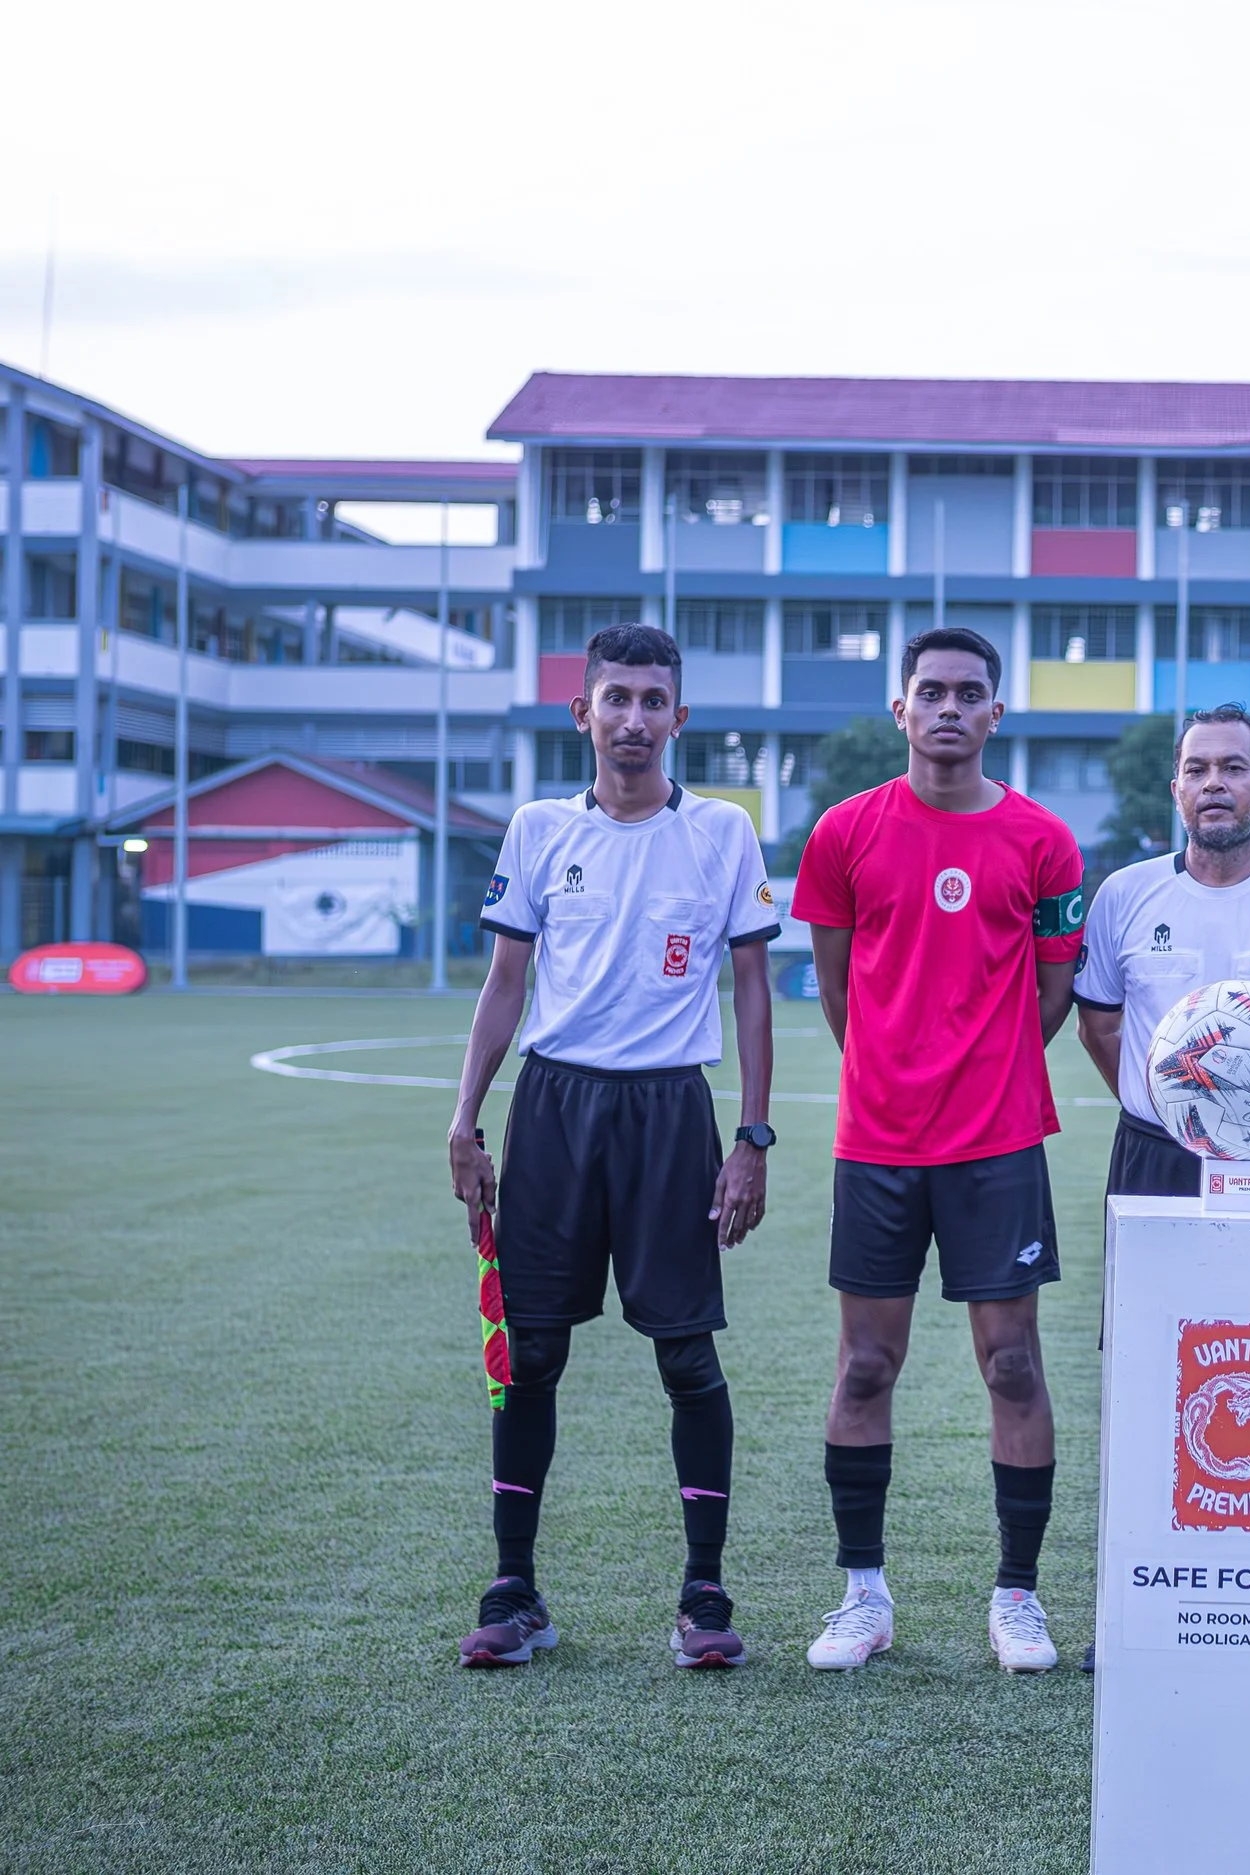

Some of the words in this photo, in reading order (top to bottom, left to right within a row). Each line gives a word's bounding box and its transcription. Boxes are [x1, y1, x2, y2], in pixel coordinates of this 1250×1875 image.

[1066, 894, 1083, 924] C
[1132, 1566, 1208, 1588] SAFE
[1178, 1612, 1202, 1624] NO
